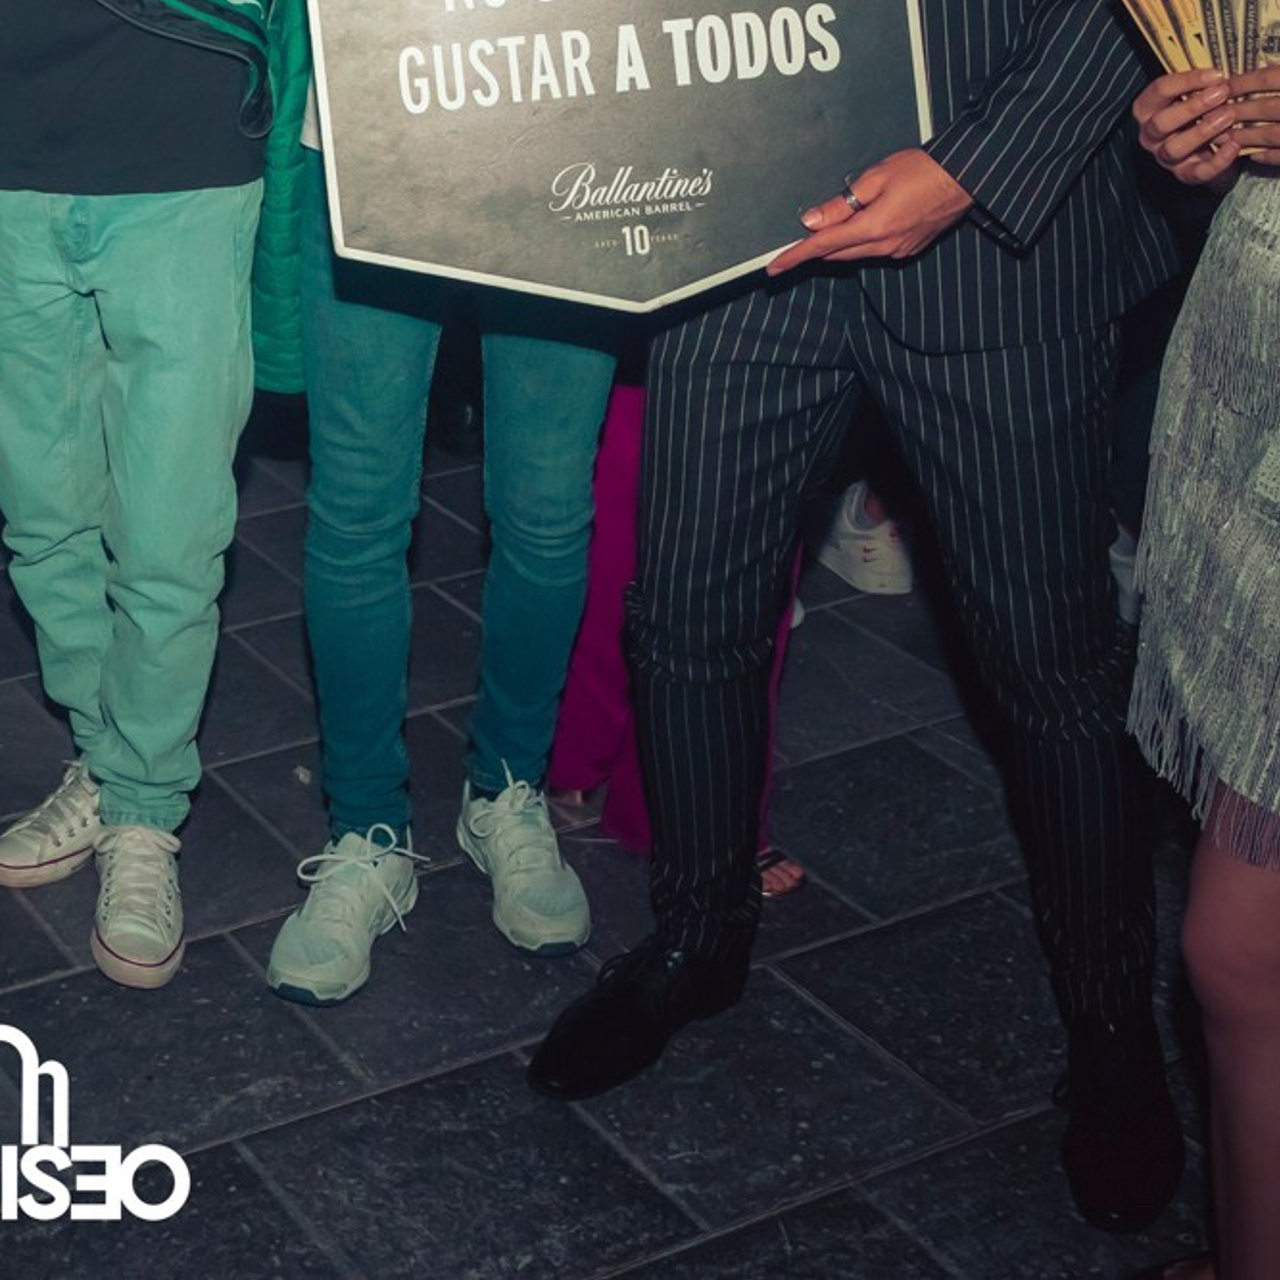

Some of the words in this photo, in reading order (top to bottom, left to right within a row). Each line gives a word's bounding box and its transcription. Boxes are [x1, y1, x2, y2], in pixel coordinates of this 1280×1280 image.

[398, 30, 596, 114] GUSTAR
[615, 24, 651, 93] A
[662, 2, 842, 87] TODOS
[548, 162, 714, 212] Ballantine's
[574, 207, 641, 222] AMERICAN
[645, 201, 693, 216] BARREL
[621, 224, 651, 256] 10
